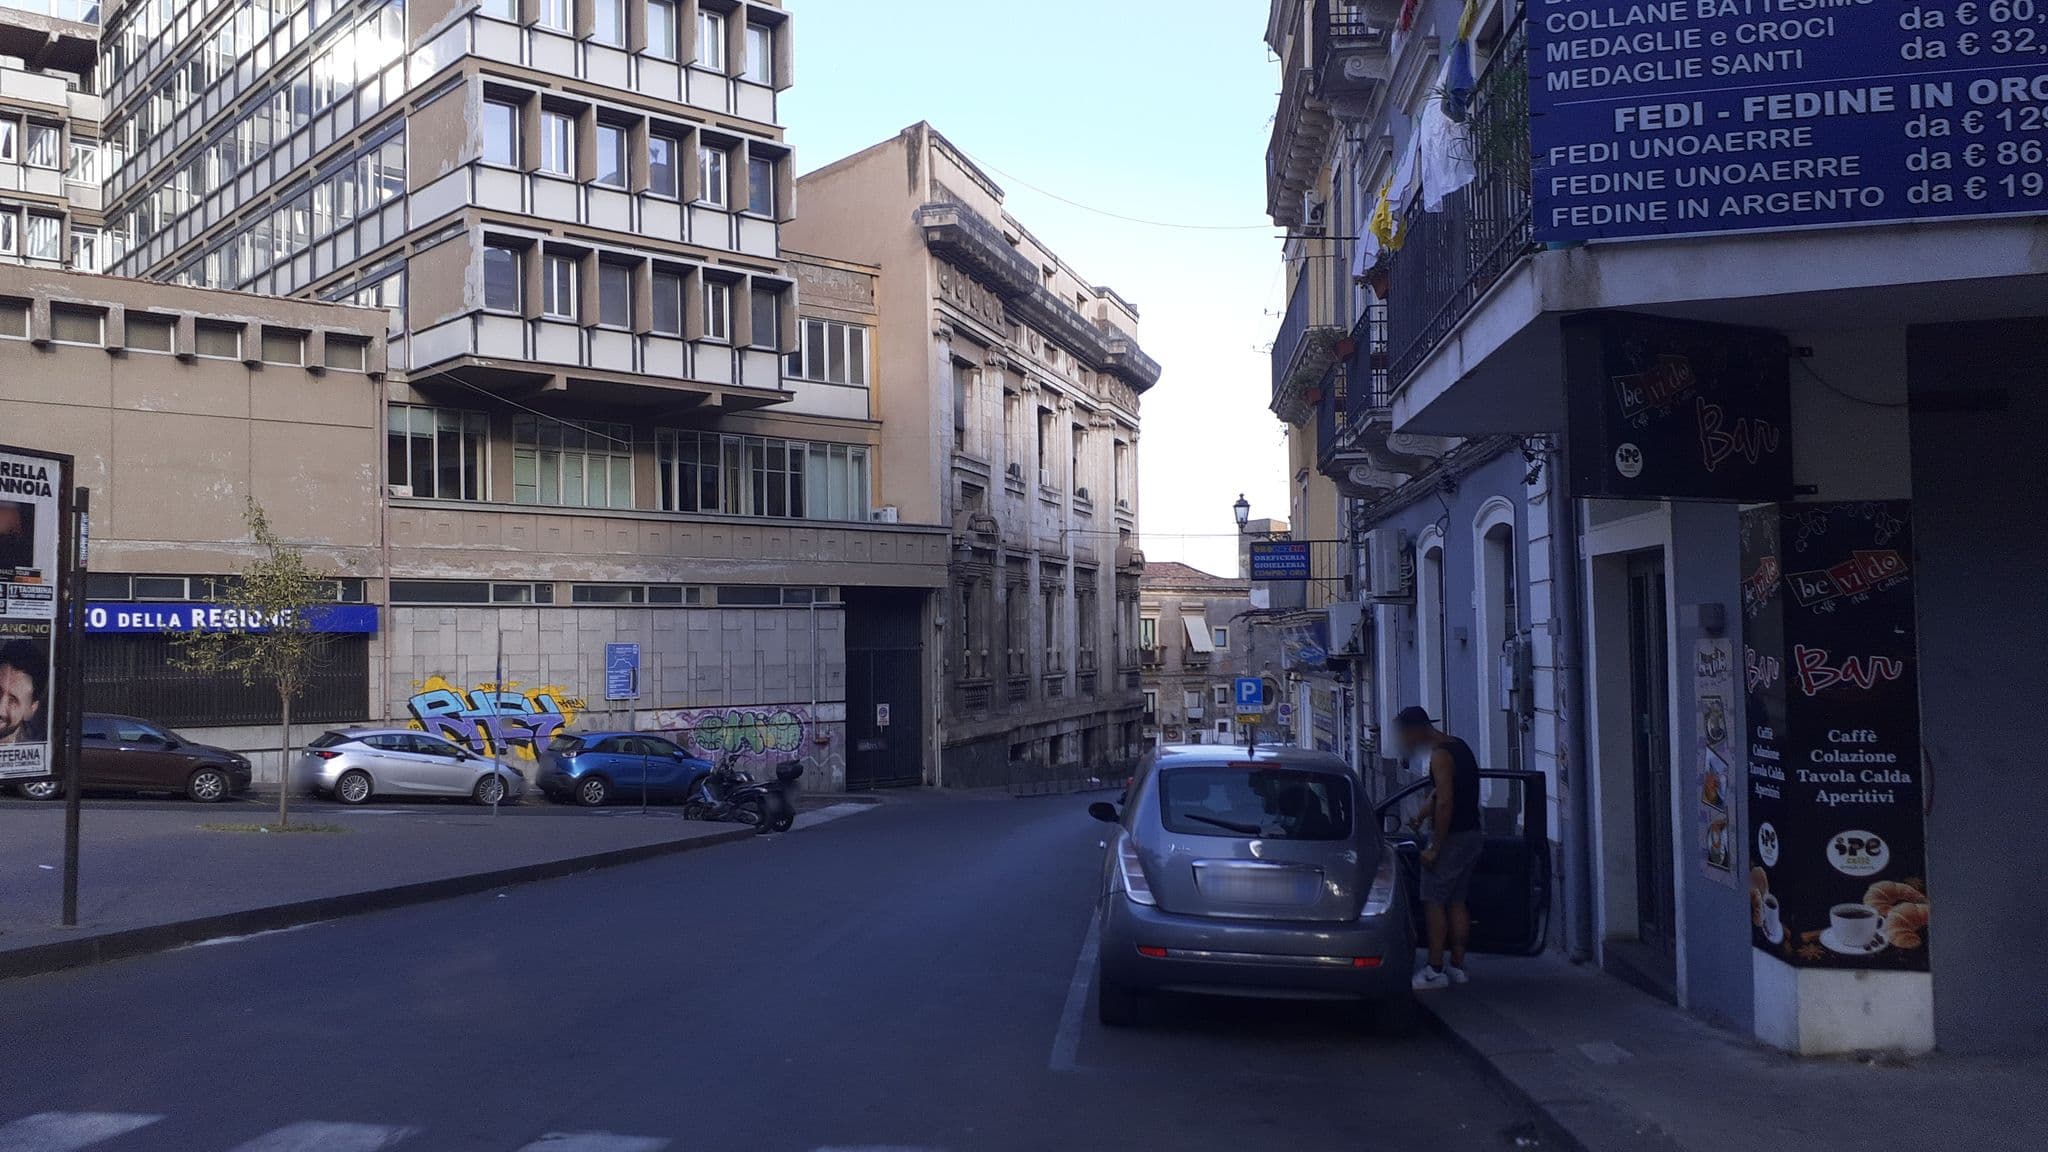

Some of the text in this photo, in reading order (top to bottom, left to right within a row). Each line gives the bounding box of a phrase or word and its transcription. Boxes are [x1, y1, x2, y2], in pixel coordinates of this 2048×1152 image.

[1546, 0, 1872, 33] COLLANE BATTE
[1547, 28, 1701, 62] MEDAGLIE
[1710, 30, 1727, 46] e
[1736, 16, 1833, 43] CROCI
[1899, 6, 1945, 30] da
[1955, 2, 1978, 25] €
[1547, 57, 1702, 91] MEDAGLIE
[1711, 49, 1802, 76] SANTI
[1901, 36, 1947, 60] da
[1957, 32, 1980, 55] €
[1614, 101, 1704, 132] FEDI
[1743, 85, 1895, 122] FEDINE
[1910, 82, 1953, 109] IN
[1550, 141, 1620, 166] FEDI
[1629, 126, 1814, 160] UNOAERRE
[1904, 114, 1951, 138] da
[1961, 110, 1985, 134] €
[1551, 170, 1665, 197] FEDINE
[1675, 155, 1861, 188] UNOAERRE
[1905, 147, 1952, 171] da
[1962, 143, 1986, 167] €
[1552, 200, 1668, 228] FEDINE
[1678, 197, 1708, 220] IN
[1719, 186, 1885, 217] ARGENTO
[1906, 179, 1953, 204] da
[1963, 175, 1988, 200] €
[1696, 396, 1779, 472] Bar
[0, 462, 48, 481] RELLA
[0, 624, 50, 634] ANCINO
[118, 613, 181, 628] DELLA
[1794, 643, 1904, 697] Bar
[1241, 681, 1257, 701] P
[1827, 729, 1878, 742] Caffè
[1810, 749, 1897, 763] Colazione
[1796, 769, 1913, 783] Tavola Calda
[1816, 788, 1895, 807] Aperitivi
